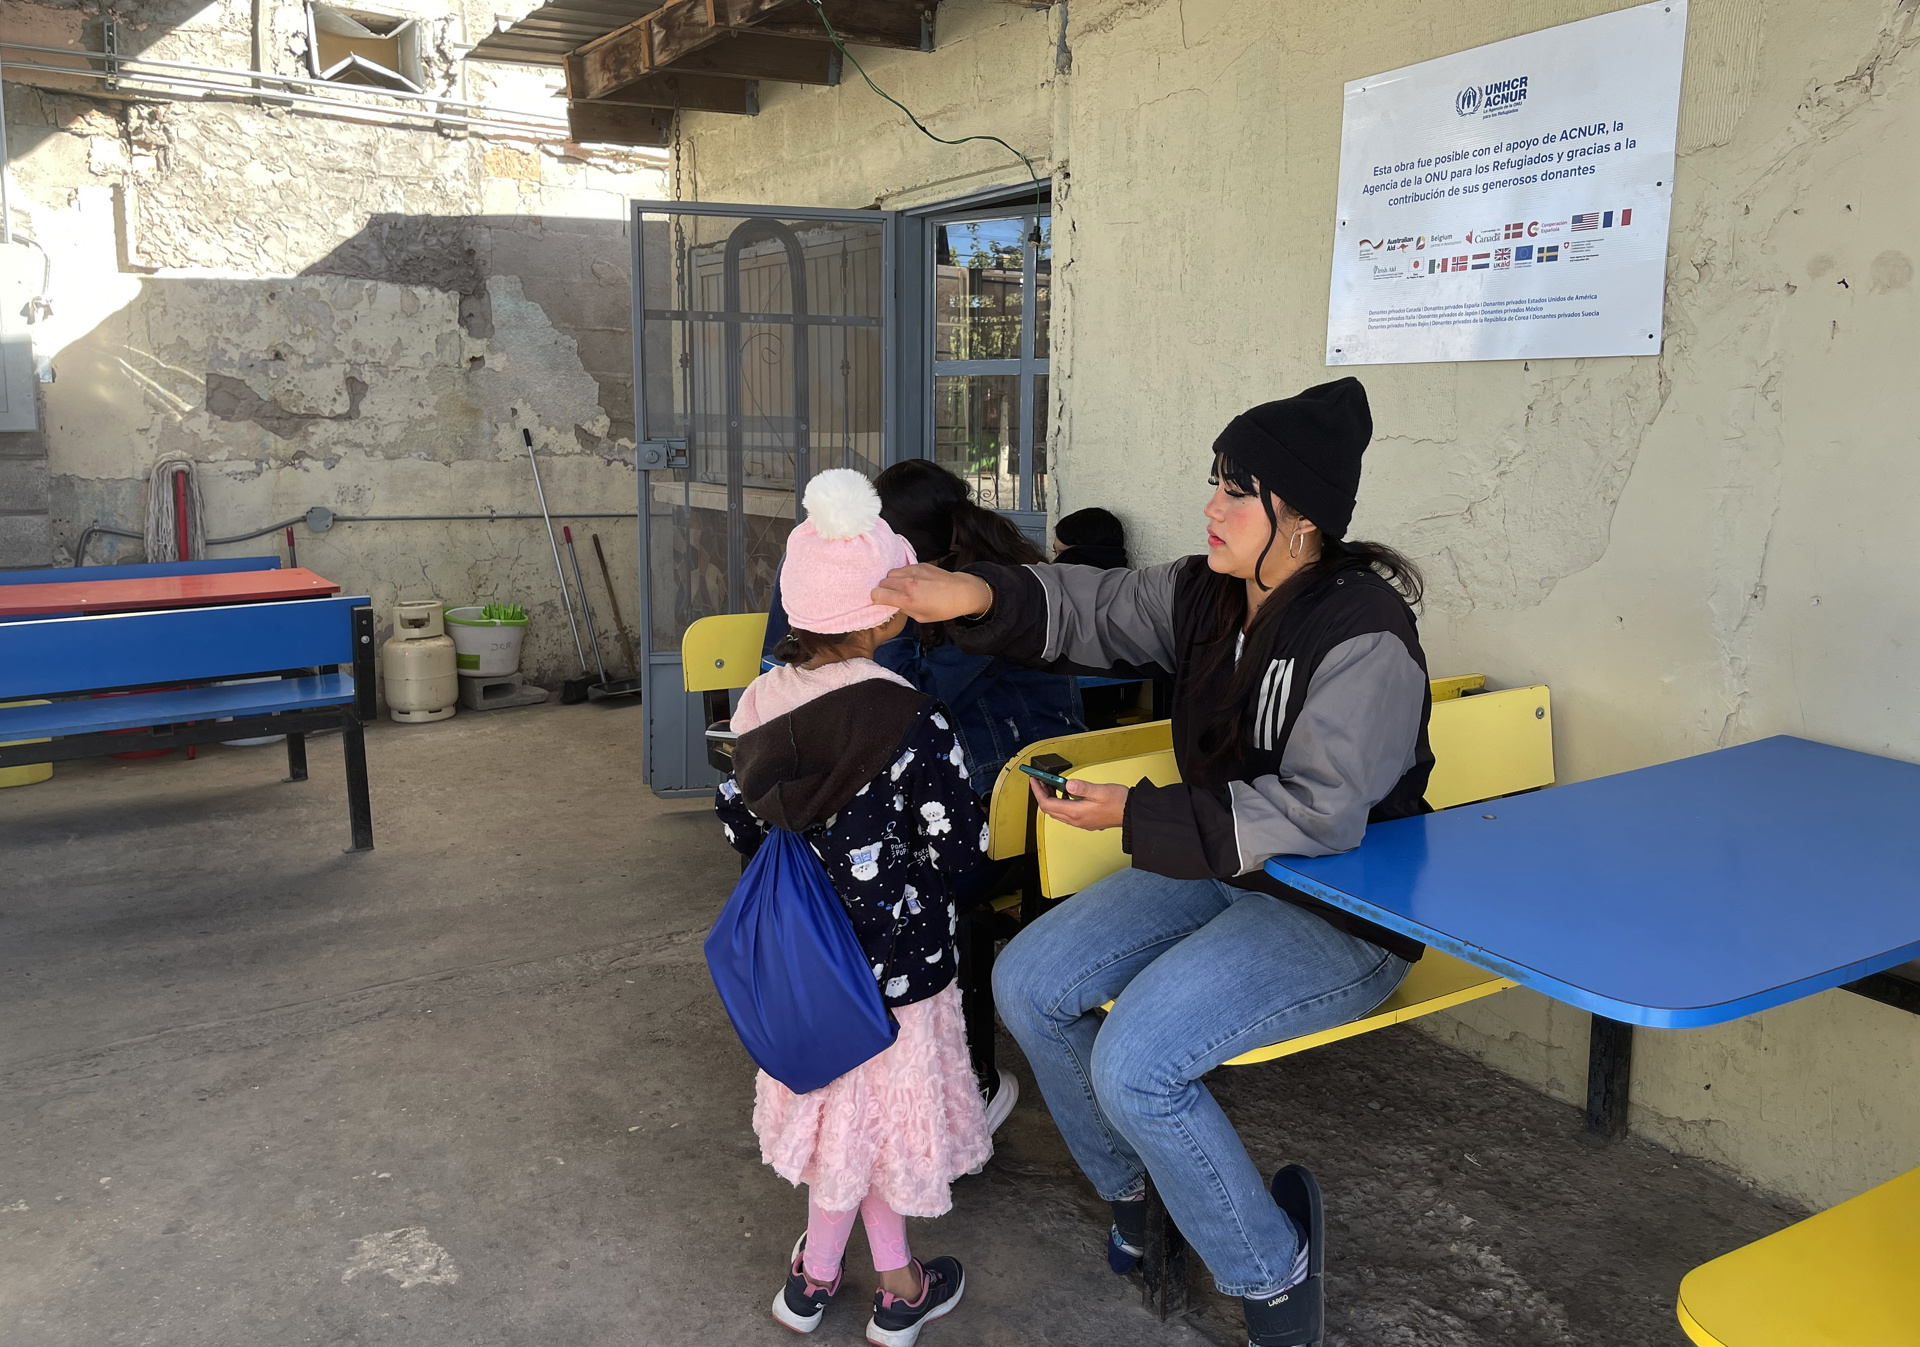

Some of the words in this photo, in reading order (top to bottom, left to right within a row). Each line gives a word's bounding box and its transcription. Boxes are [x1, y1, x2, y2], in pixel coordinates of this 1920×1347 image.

[1485, 76, 1528, 96] UNHCR
[1484, 88, 1527, 108] ACNUR
[1374, 166, 1392, 176] Esta
[1394, 161, 1415, 172] obra
[1417, 158, 1432, 168] fue
[1435, 150, 1469, 167] posible
[1472, 147, 1490, 157] con
[1494, 142, 1503, 153] el
[1506, 138, 1539, 153] apoyo
[1542, 133, 1556, 145] de
[1560, 123, 1609, 141] ACNUR,
[1613, 120, 1624, 132] la
[1363, 180, 1397, 195] Agencia
[1400, 178, 1411, 188] de
[1414, 176, 1422, 185] la
[1425, 170, 1448, 183] ONU
[1450, 168, 1472, 181] para
[1475, 164, 1489, 174] los
[1493, 153, 1553, 171] Refugiados
[1557, 151, 1564, 163] y
[1567, 143, 1610, 161] gracias
[1614, 142, 1621, 151] a
[1626, 138, 1636, 149] la
[1388, 188, 1445, 206] contribución
[1448, 186, 1460, 196] de
[1463, 183, 1479, 194] sus
[1482, 174, 1537, 193] generosos
[1541, 165, 1595, 181] donantes
[1387, 236, 1414, 244] Australian
[1431, 234, 1452, 242] Belgium
[1475, 233, 1500, 243] Canada
[1268, 1294, 1289, 1307] LARGO
